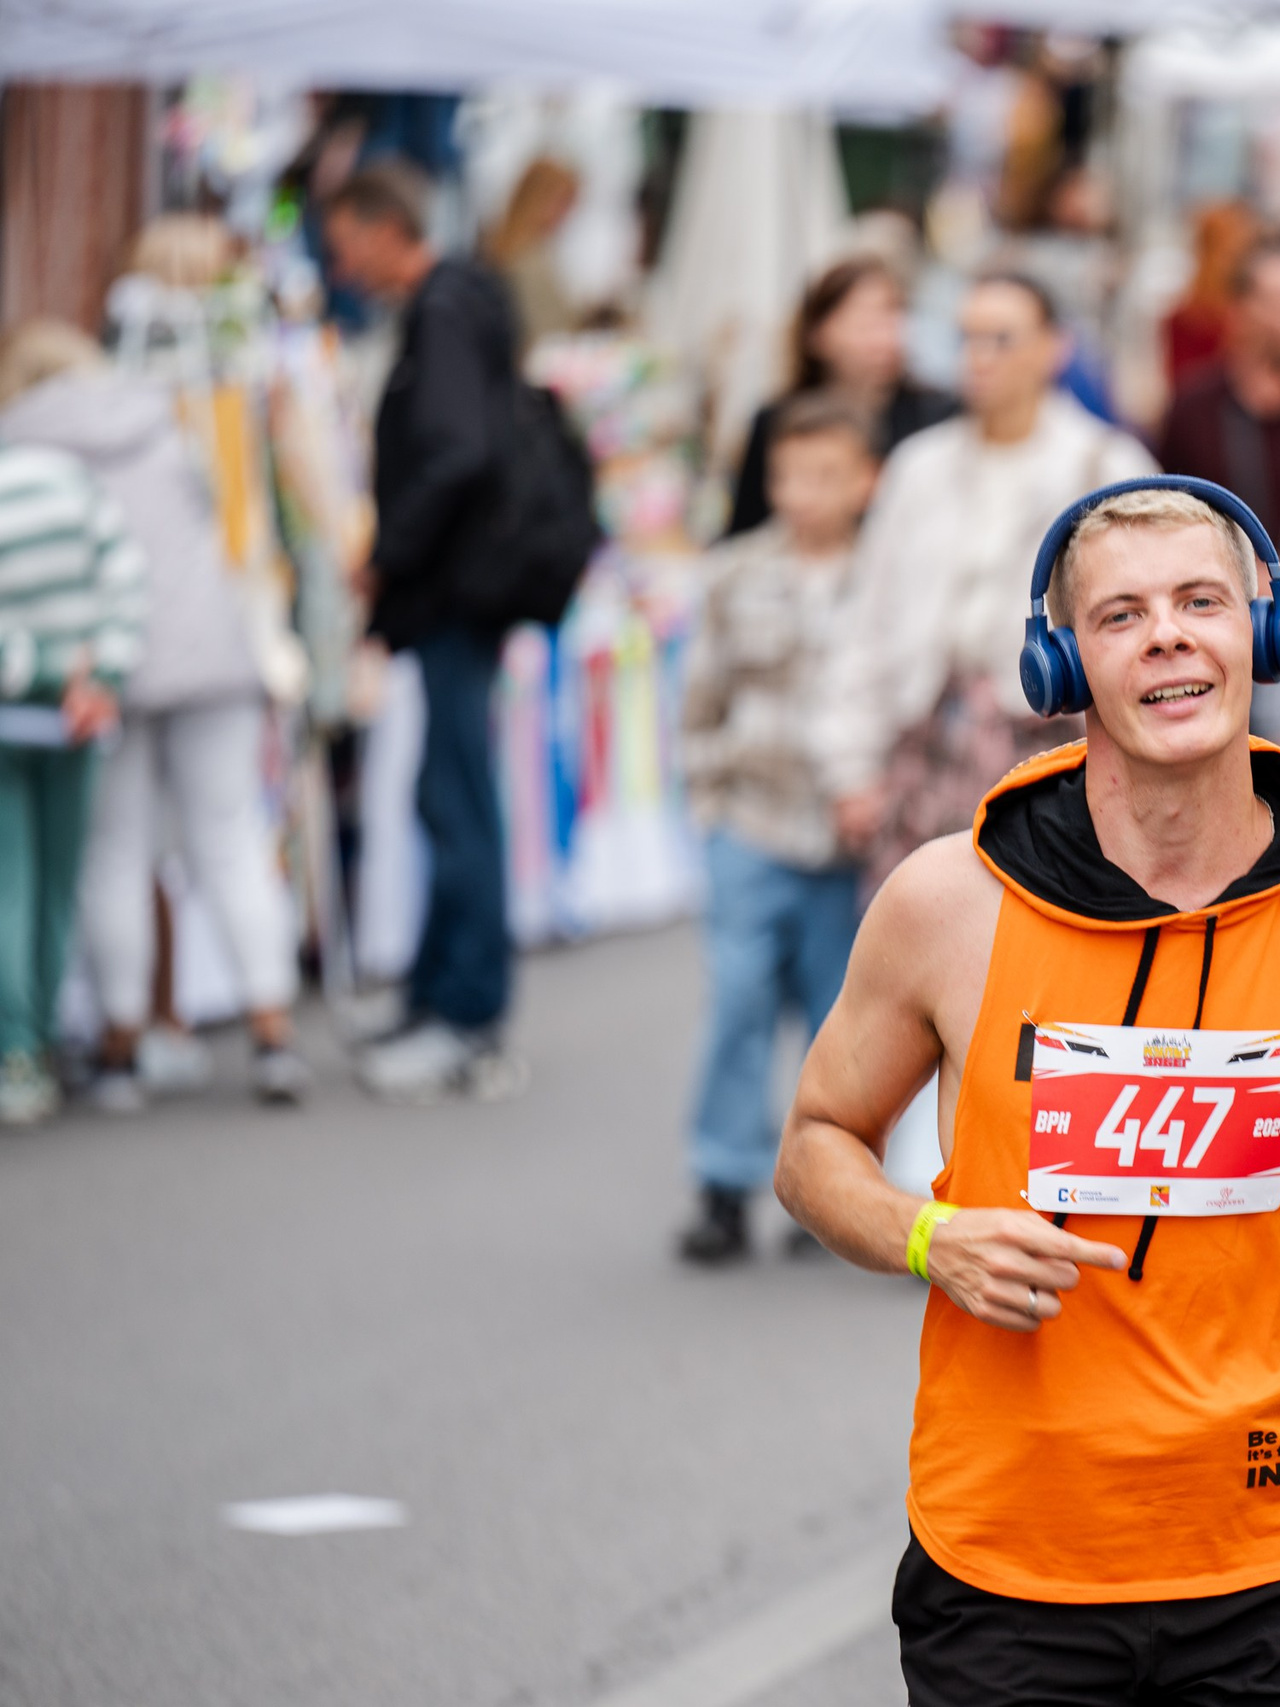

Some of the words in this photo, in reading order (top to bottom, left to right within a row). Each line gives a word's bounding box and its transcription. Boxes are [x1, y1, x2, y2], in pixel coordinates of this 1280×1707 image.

[1094, 1084, 1236, 1169] 447
[1248, 1430, 1278, 1448] Be
[1247, 1448, 1272, 1462] it's
